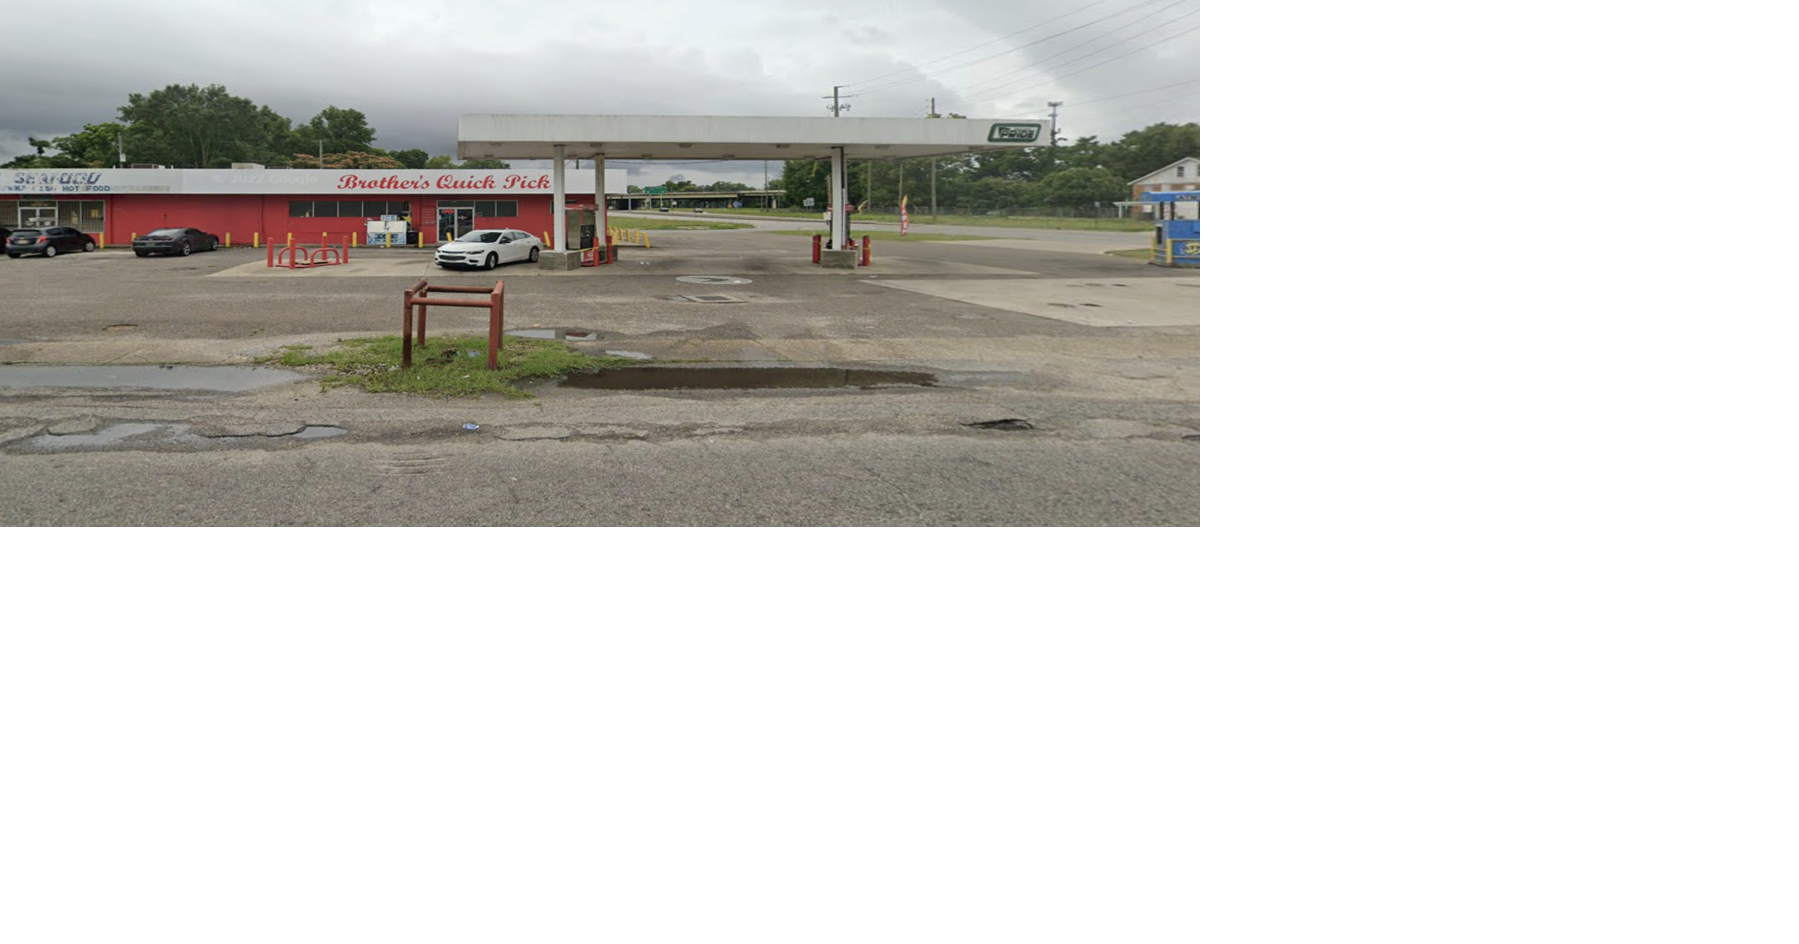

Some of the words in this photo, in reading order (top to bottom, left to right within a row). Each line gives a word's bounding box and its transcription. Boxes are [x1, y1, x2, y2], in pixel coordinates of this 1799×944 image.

[337, 174, 430, 189] Brother's
[436, 174, 497, 189] Quick
[503, 174, 551, 189] Pick
